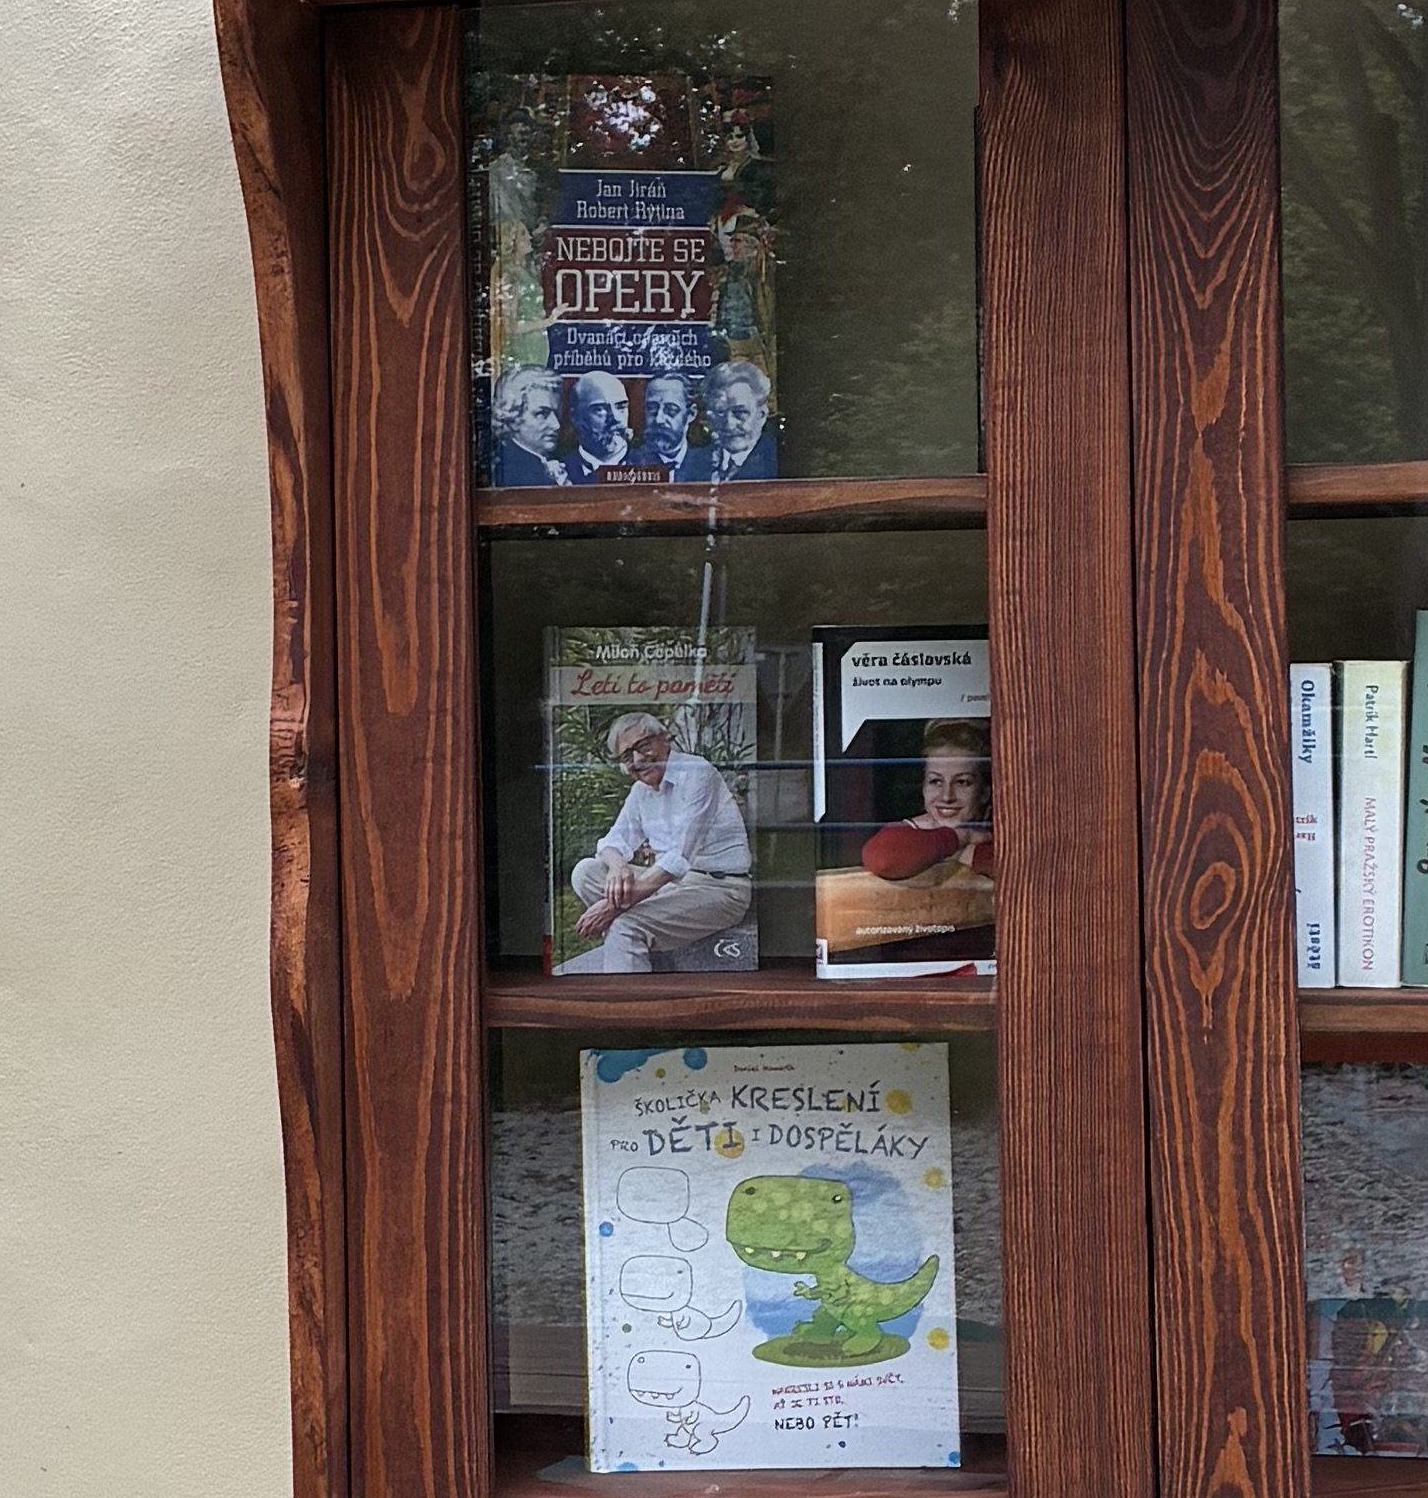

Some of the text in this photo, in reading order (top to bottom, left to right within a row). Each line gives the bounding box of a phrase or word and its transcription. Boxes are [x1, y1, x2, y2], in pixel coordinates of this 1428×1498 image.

[596, 179, 622, 197] Jan
[576, 200, 629, 219] Robert
[555, 236, 705, 263] NEBOJTE SE
[555, 268, 705, 314] OPERY
[618, 354, 644, 370] pro
[852, 651, 972, 667] věra čáslavská
[627, 673, 652, 694] to
[852, 676, 943, 688] život na olympu
[1298, 679, 1317, 764] Okamžiky
[1361, 685, 1379, 971] Patrik Hartl MALÝ PRAŽSKÝ EROTIKON
[634, 1080, 882, 1117] ŠKOLIČKA KRESLENÍ
[610, 1115, 930, 1160] PRO DĚTI I DOSPĚLÁKY
[774, 1410, 860, 1431] NEBO PĚT!
